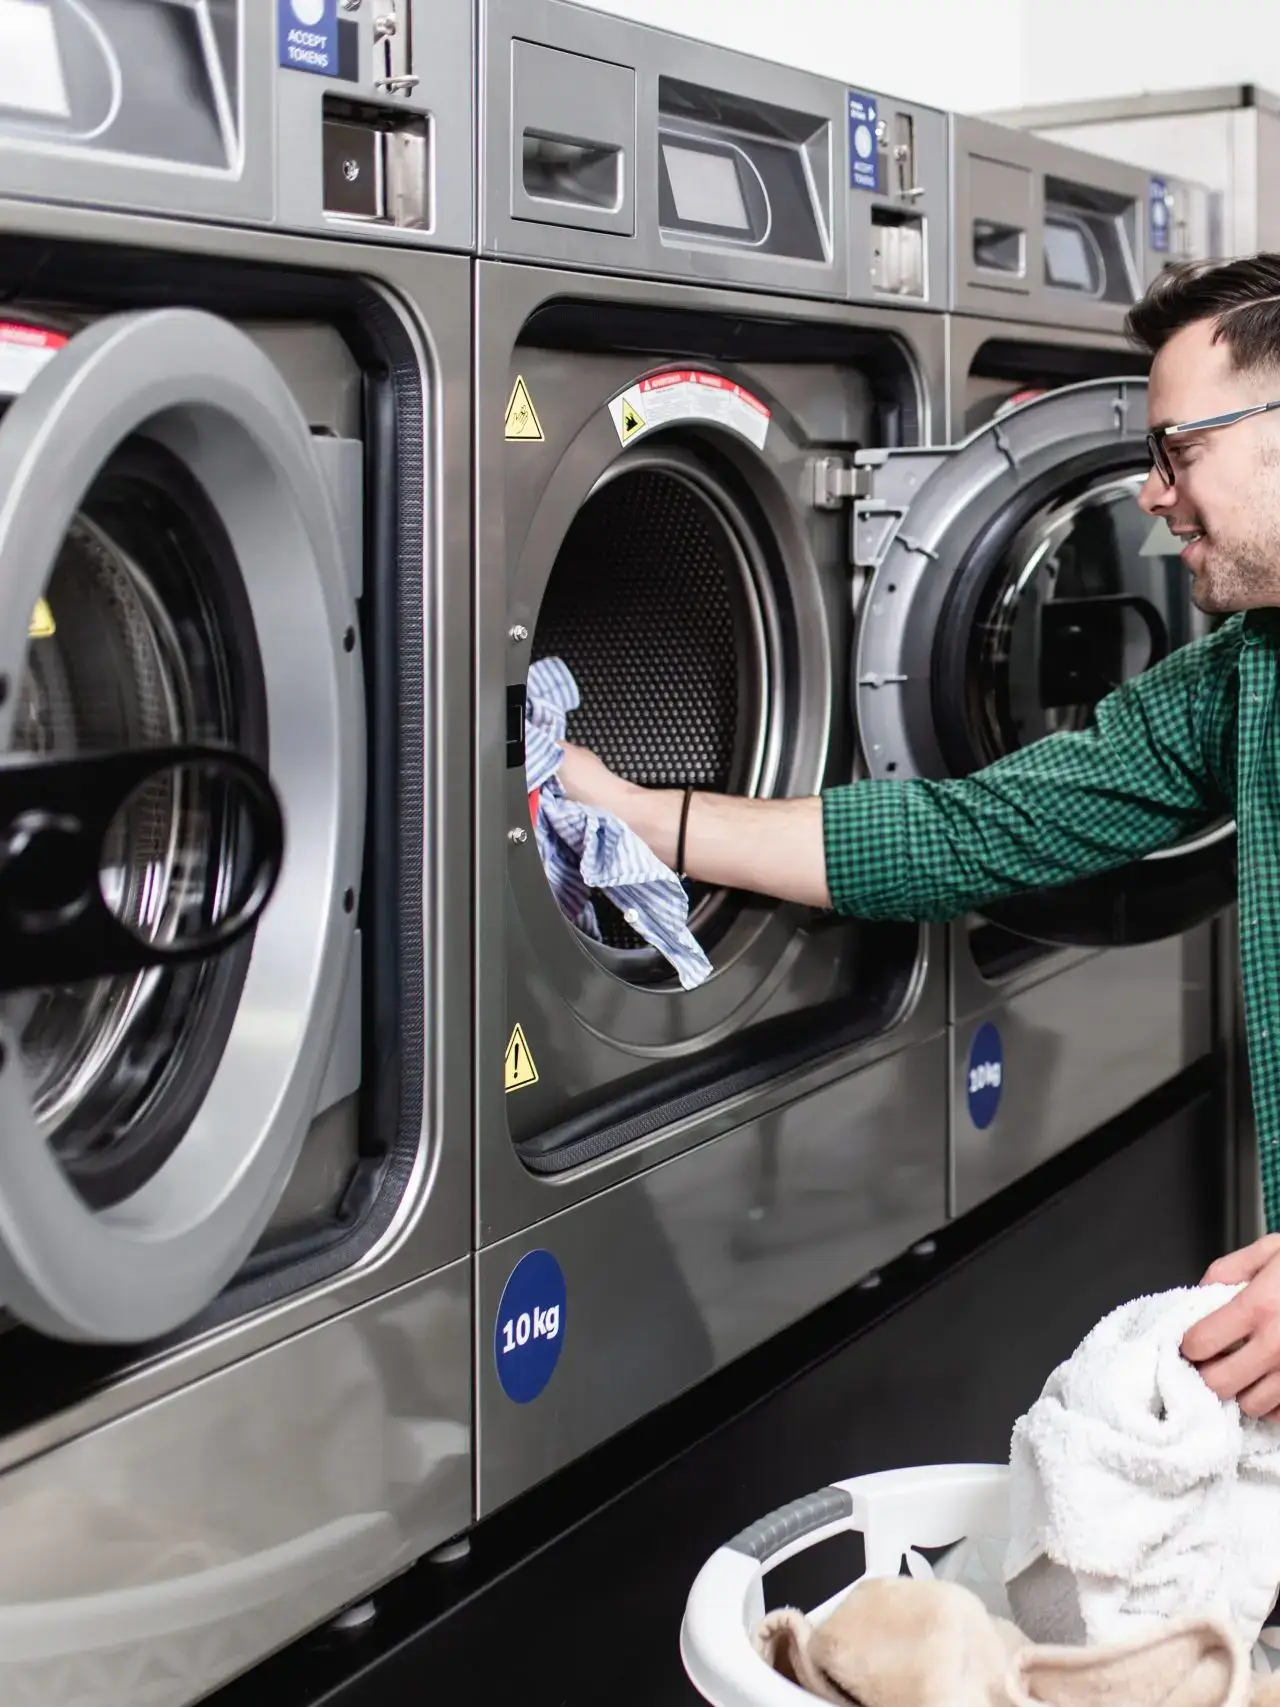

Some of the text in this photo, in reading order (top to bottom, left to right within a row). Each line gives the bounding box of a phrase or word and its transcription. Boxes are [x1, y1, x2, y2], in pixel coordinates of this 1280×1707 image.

[287, 28, 328, 49] ACCEPT
[288, 46, 329, 68] TOKENS
[503, 1304, 560, 1354] 10 kg
